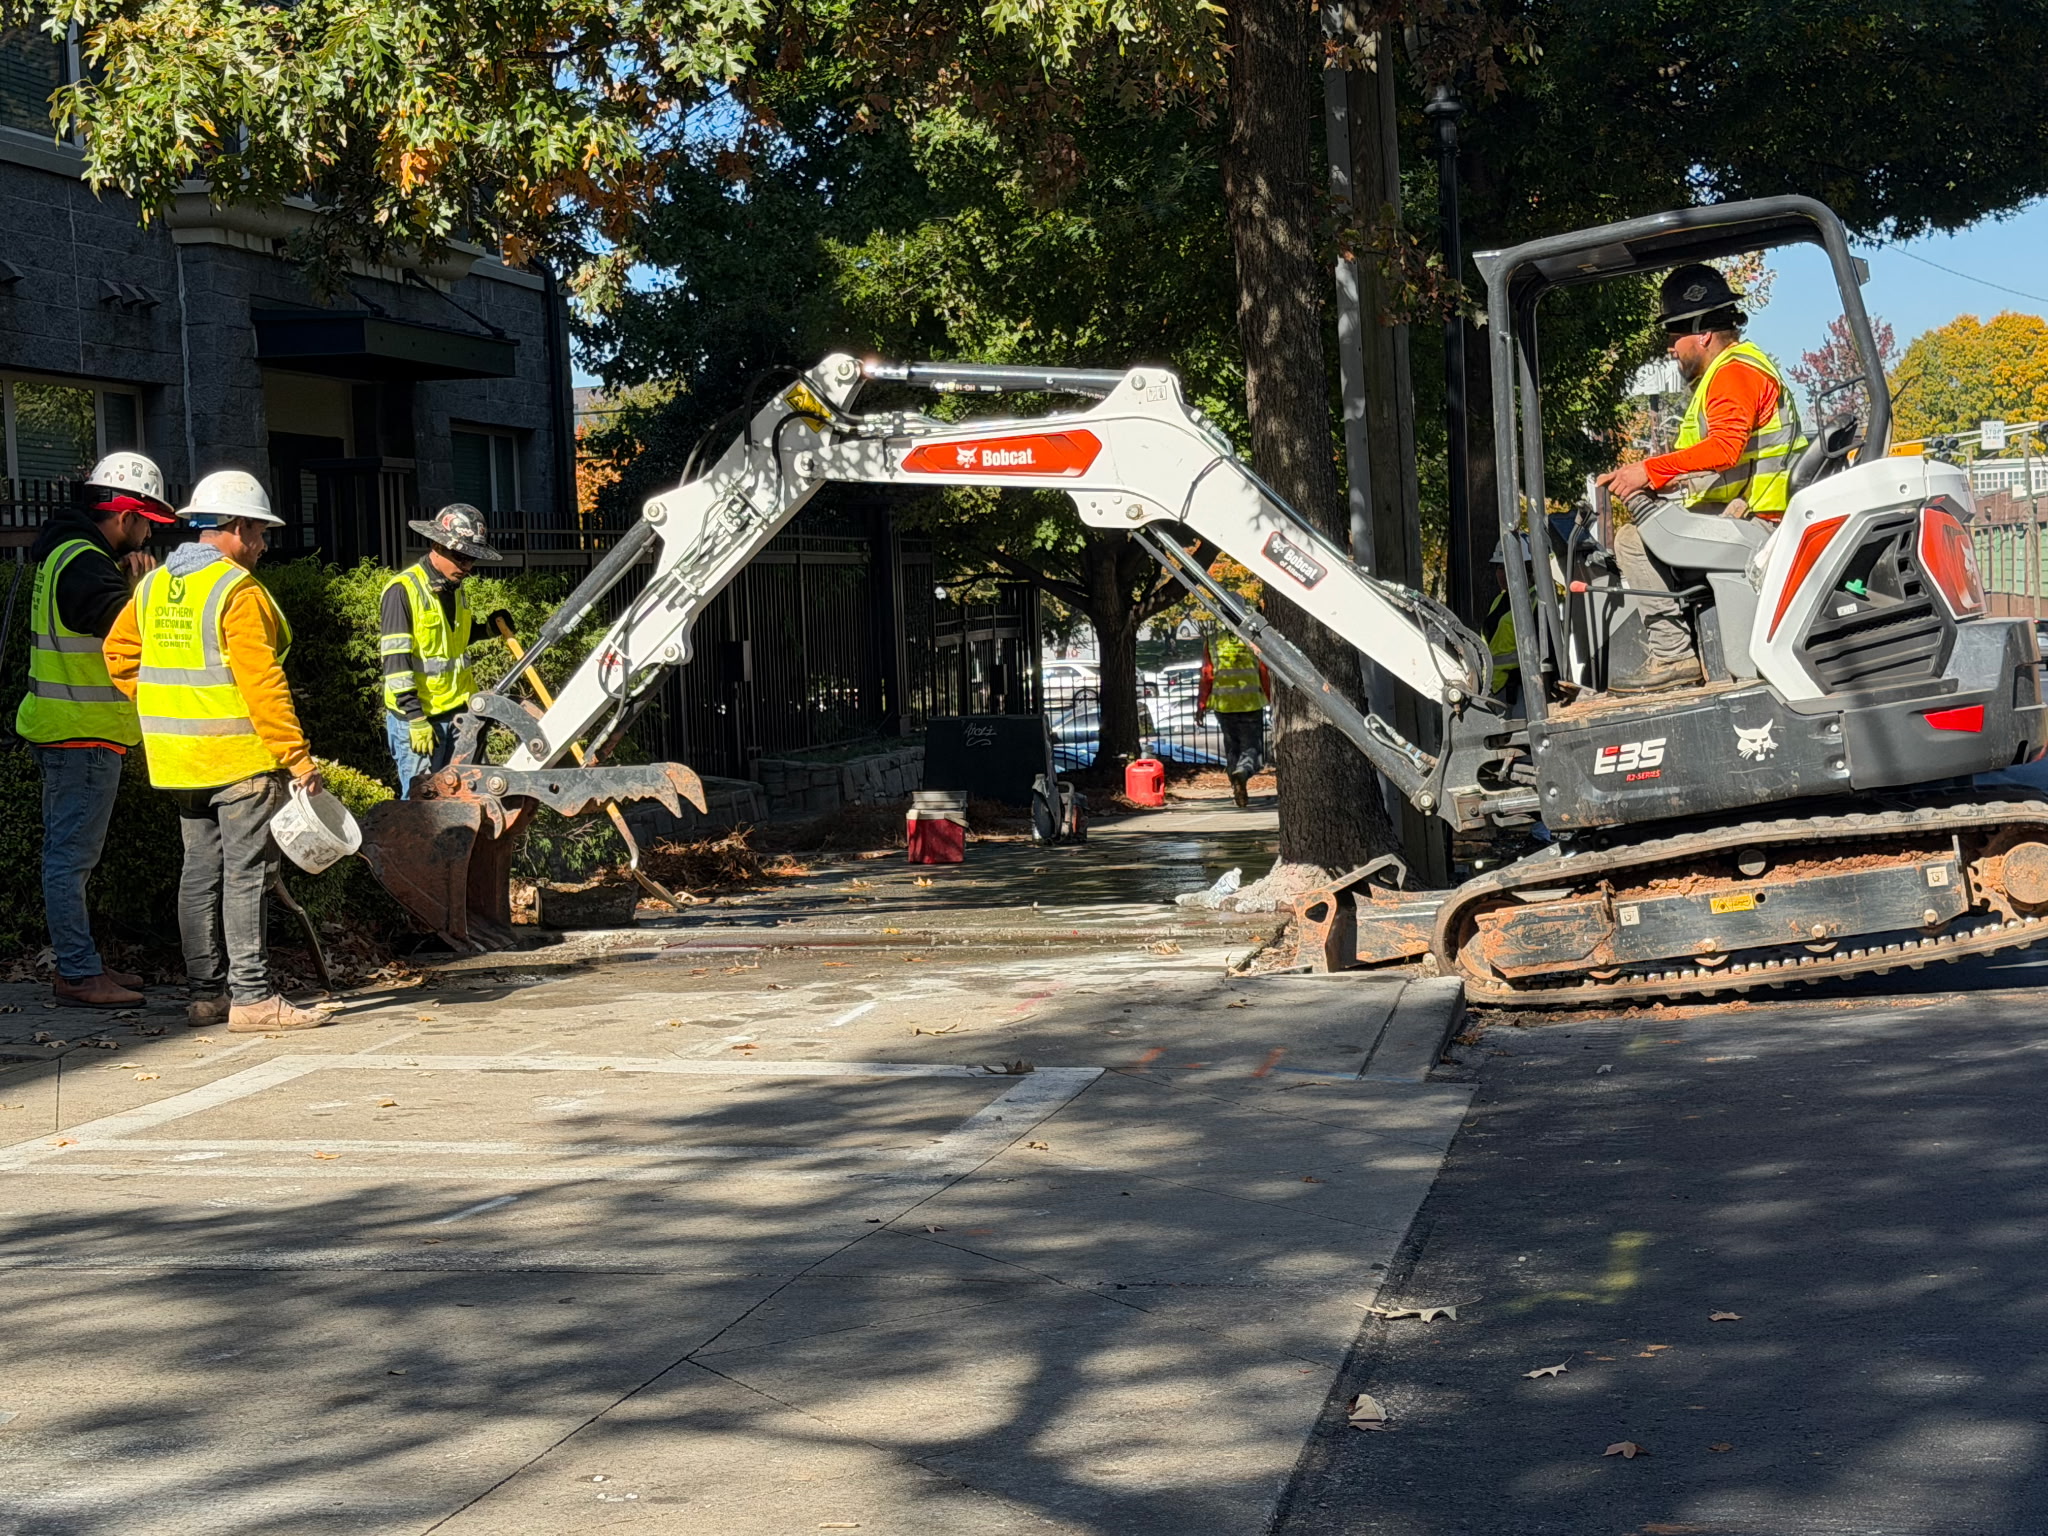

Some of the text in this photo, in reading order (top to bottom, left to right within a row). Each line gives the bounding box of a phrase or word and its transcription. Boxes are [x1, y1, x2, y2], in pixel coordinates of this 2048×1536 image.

[982, 448, 1034, 467] Bobcat
[1283, 548, 1318, 580] Bobcat
[155, 606, 194, 618] SOUTHERN
[1594, 738, 1667, 775] E35
